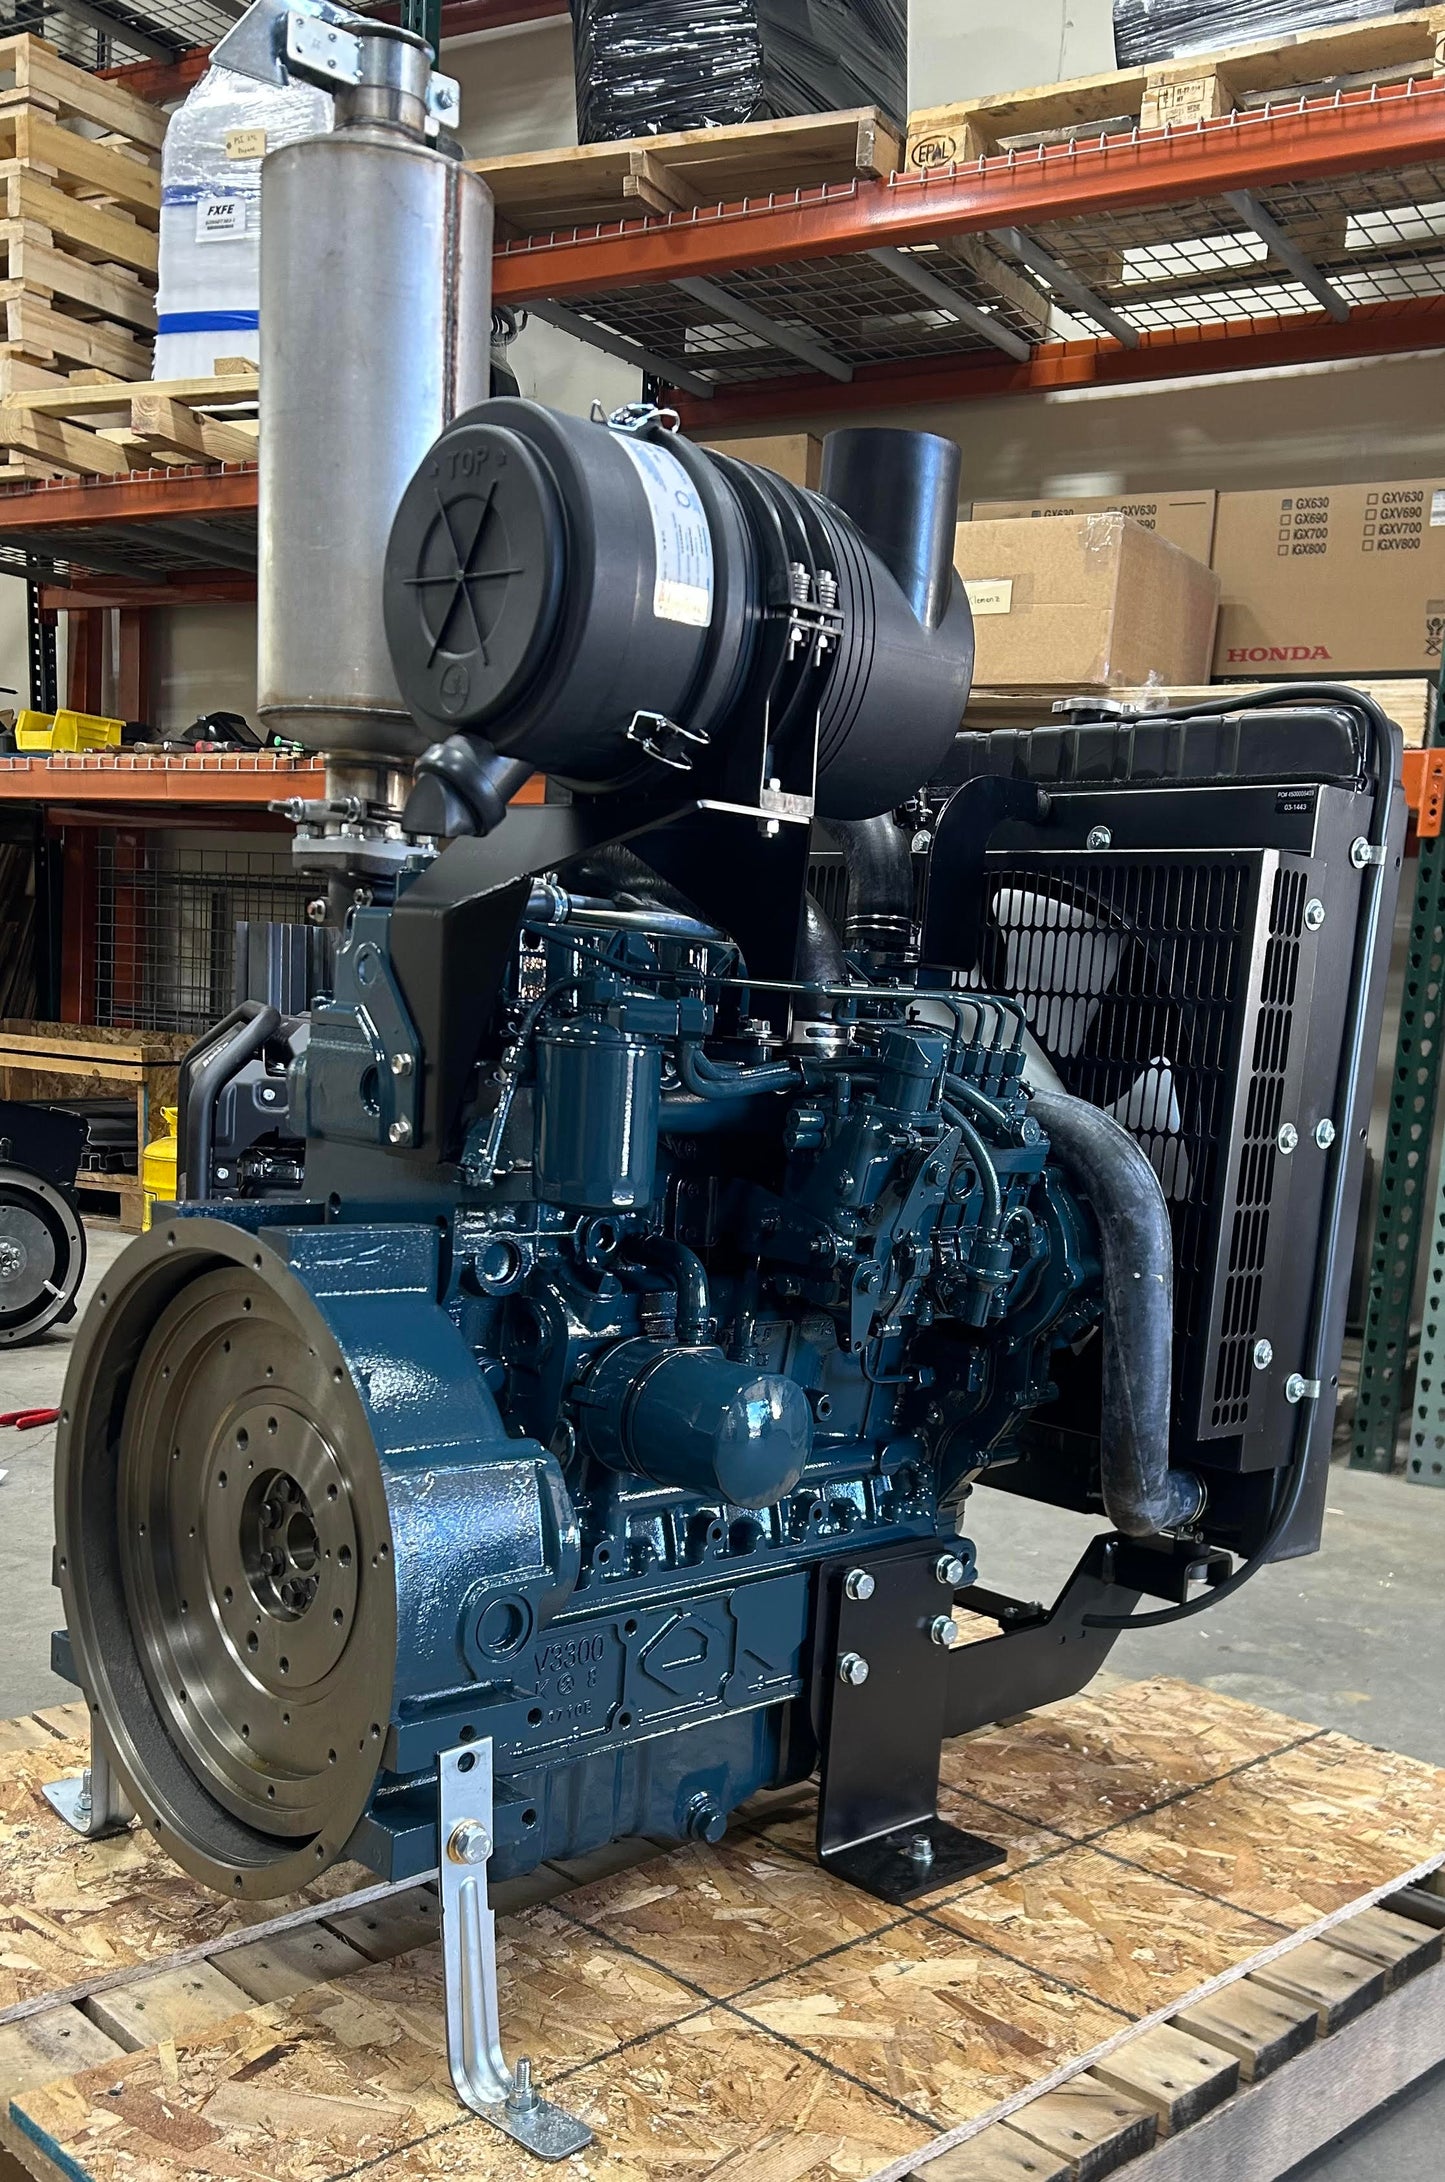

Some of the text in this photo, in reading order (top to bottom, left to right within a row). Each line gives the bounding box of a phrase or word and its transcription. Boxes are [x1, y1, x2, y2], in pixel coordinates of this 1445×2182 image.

[918, 141, 949, 163] EPAL
[207, 204, 235, 216] FXFE
[446, 445, 490, 481] TOP
[1296, 496, 1330, 510] GX630
[1382, 491, 1424, 504] GXV630
[1121, 504, 1158, 517] GXV630
[1380, 506, 1422, 520] GXV690
[1294, 512, 1328, 525] GX690
[1226, 645, 1333, 663] HONDA
[1283, 803, 1307, 811] 03-1443
[534, 1634, 604, 1675] V3300
